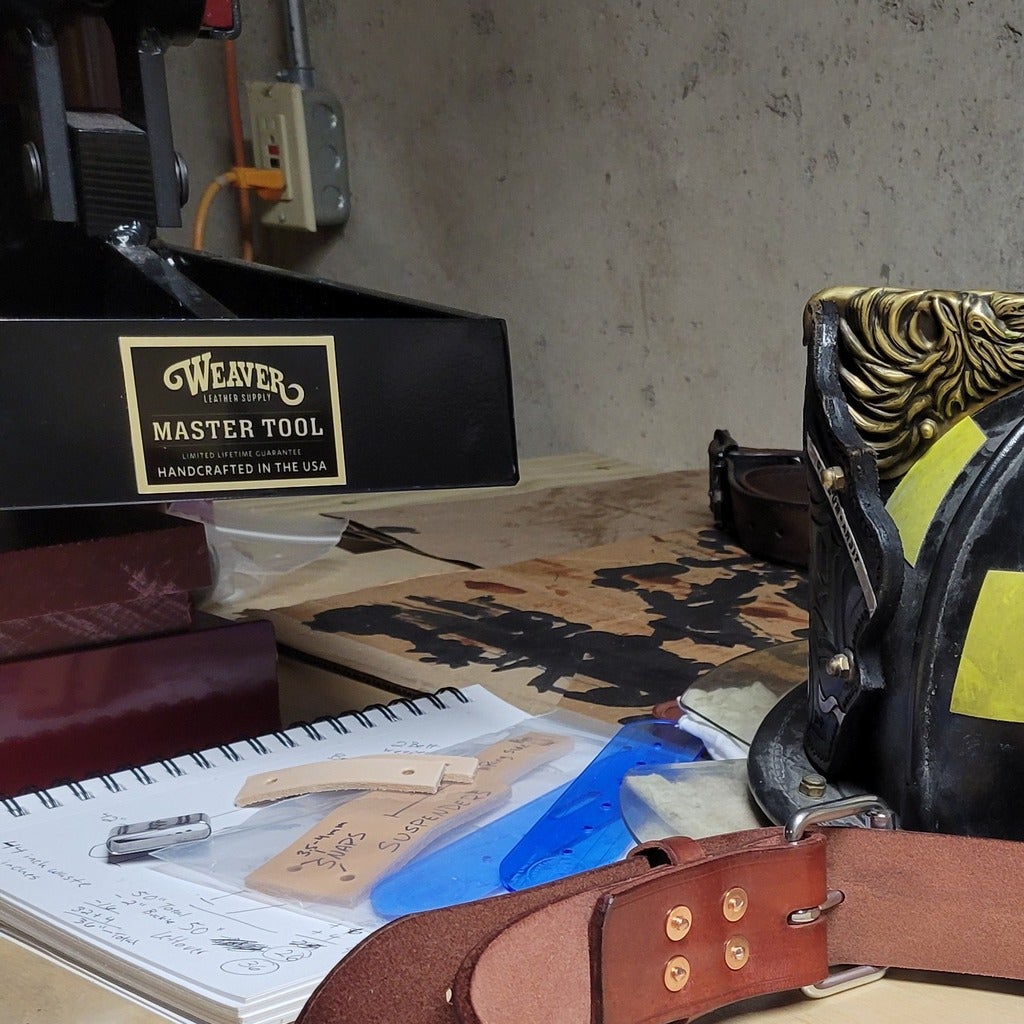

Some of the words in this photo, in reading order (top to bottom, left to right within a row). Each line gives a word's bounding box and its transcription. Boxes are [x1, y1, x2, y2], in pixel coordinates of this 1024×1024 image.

[163, 352, 305, 406] WEAVER
[203, 393, 239, 404] LEATHER
[241, 392, 272, 403] SUPPLY
[152, 419, 254, 441] MASTER
[261, 417, 324, 438] TOOL
[181, 451, 215, 460] LIMITED
[217, 449, 253, 459] LIFETIME
[255, 448, 302, 458] GUARANTEE
[157, 463, 254, 478] HANDCRAFTED
[257, 462, 271, 474] IN
[274, 461, 299, 473] THE
[302, 460, 328, 473] USA
